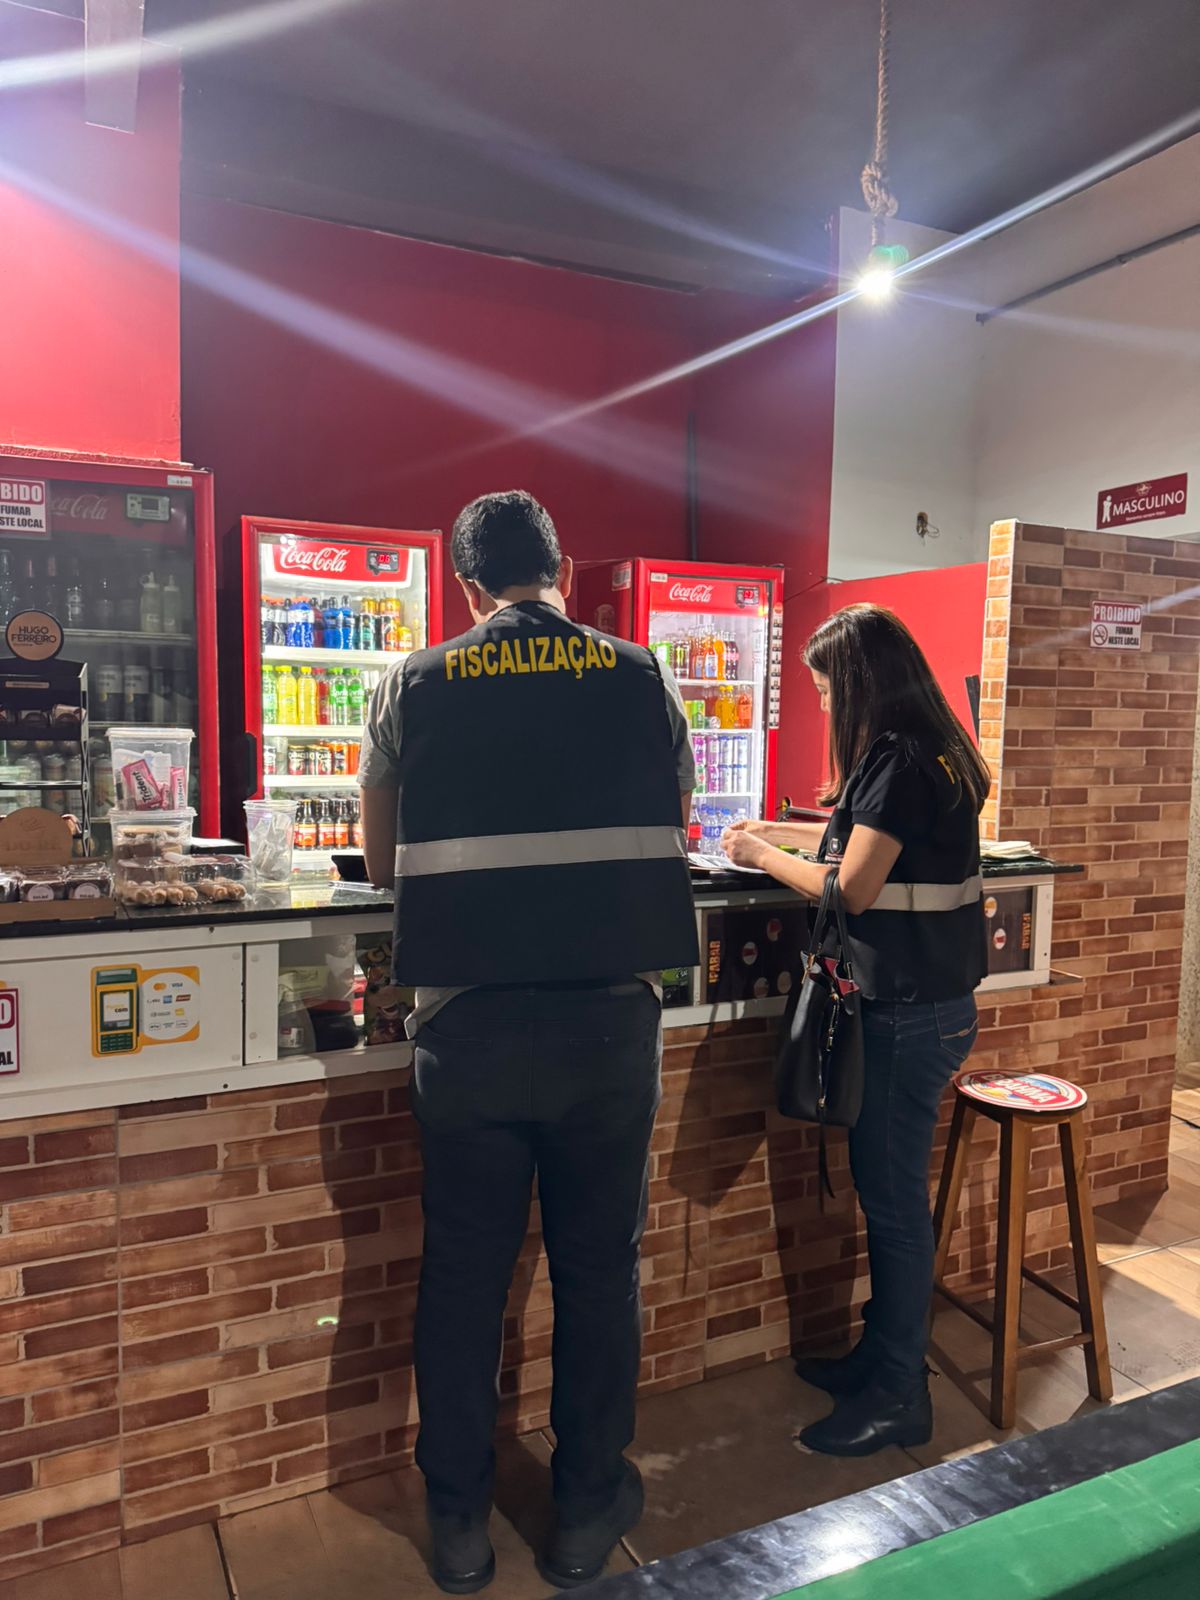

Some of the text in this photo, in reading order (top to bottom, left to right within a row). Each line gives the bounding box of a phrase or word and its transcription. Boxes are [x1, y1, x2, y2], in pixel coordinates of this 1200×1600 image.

[0, 505, 32, 516] FUMAR
[1112, 490, 1185, 516] MASCULINO
[17, 518, 44, 529] LOCAL
[280, 546, 350, 573] Coca-Cola
[669, 583, 714, 603] Coca-Cola
[1093, 605, 1140, 623] PROIBIDO
[19, 626, 49, 634] HUGO
[1115, 626, 1133, 635] FUMAR
[1108, 636, 1139, 646] NESTE LOCAL
[444, 631, 617, 680] FISCALIZAÇÃO
[132, 769, 152, 804] Trident
